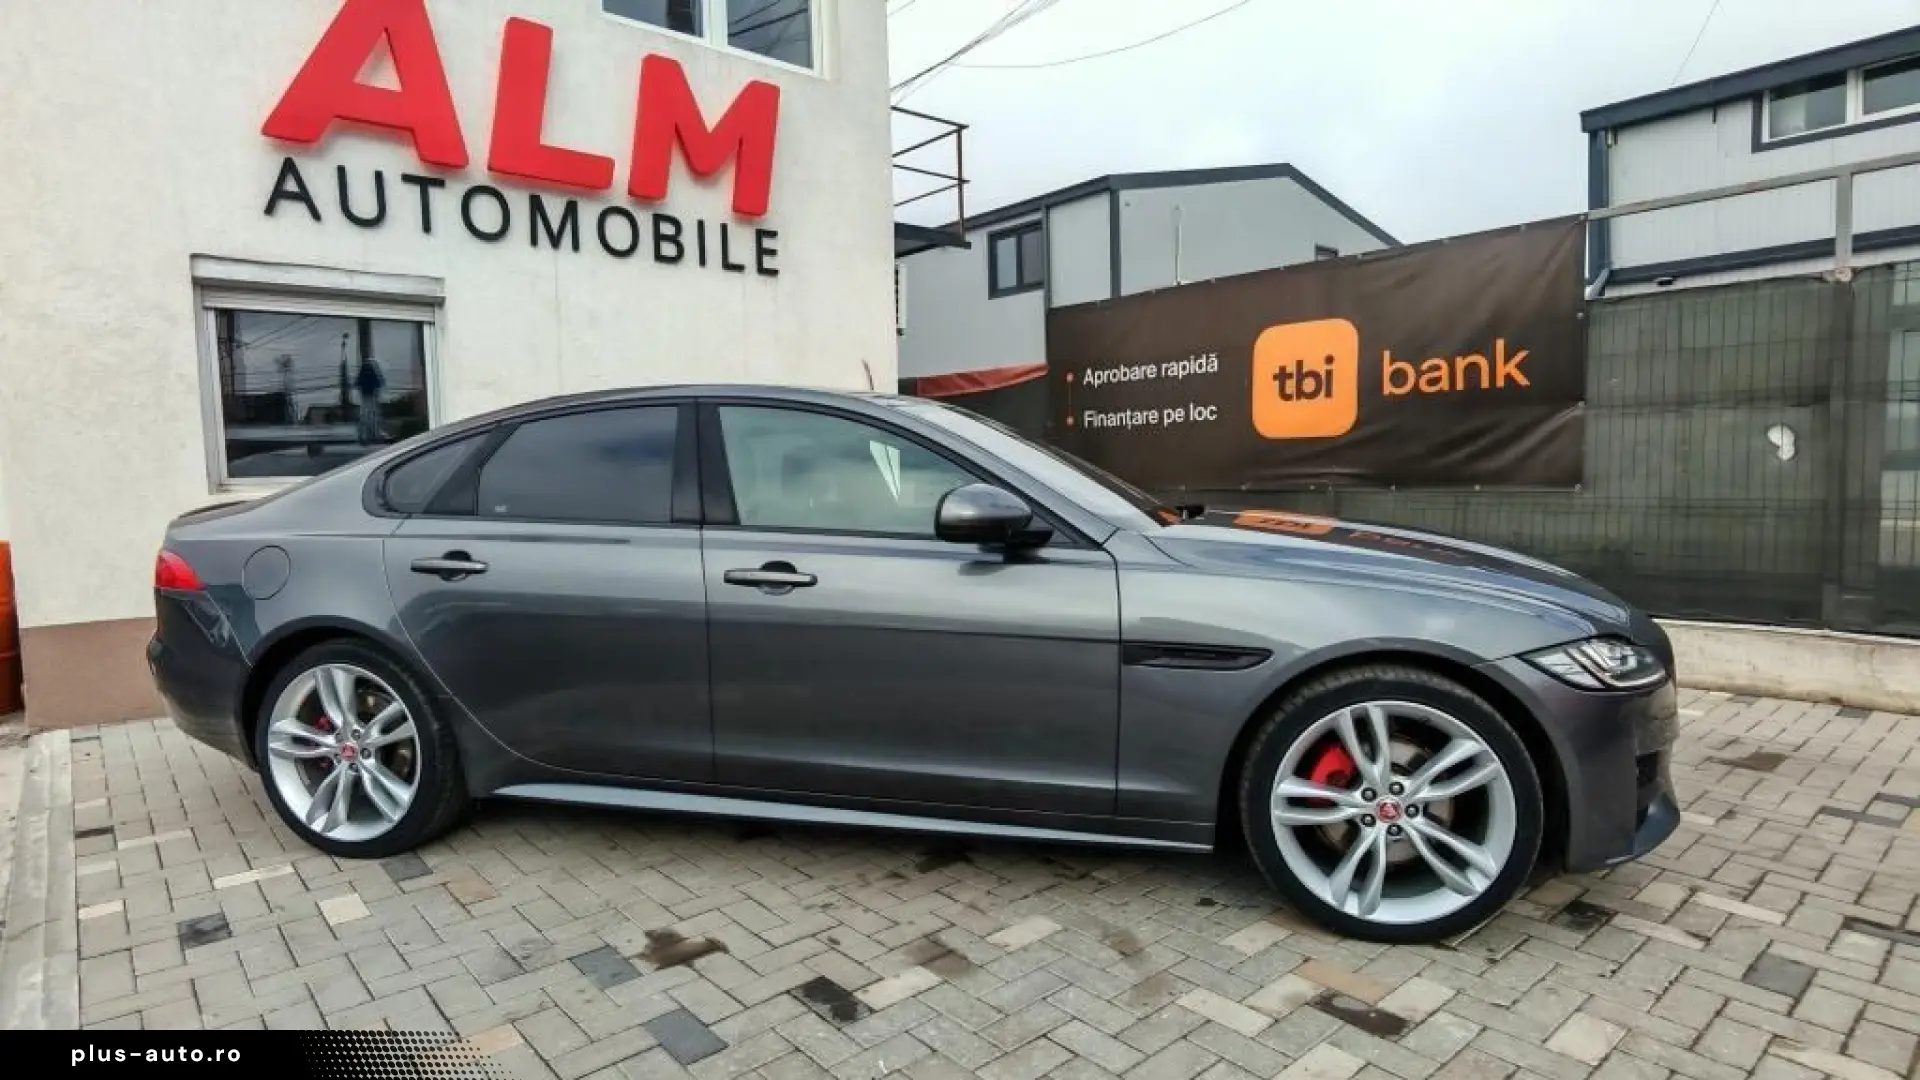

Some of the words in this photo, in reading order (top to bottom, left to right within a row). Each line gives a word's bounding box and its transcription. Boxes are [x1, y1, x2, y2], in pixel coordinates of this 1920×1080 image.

[263, 0, 780, 219] ALM
[264, 156, 779, 276] AUTOMOBILE
[1083, 364, 1157, 389] Aprobare
[1161, 353, 1218, 380] rapidă
[1272, 355, 1335, 402] tbi
[1383, 338, 1530, 395] bank
[1084, 408, 1159, 430] Finanțare
[1163, 408, 1185, 428] pe
[1189, 402, 1218, 421] loc
